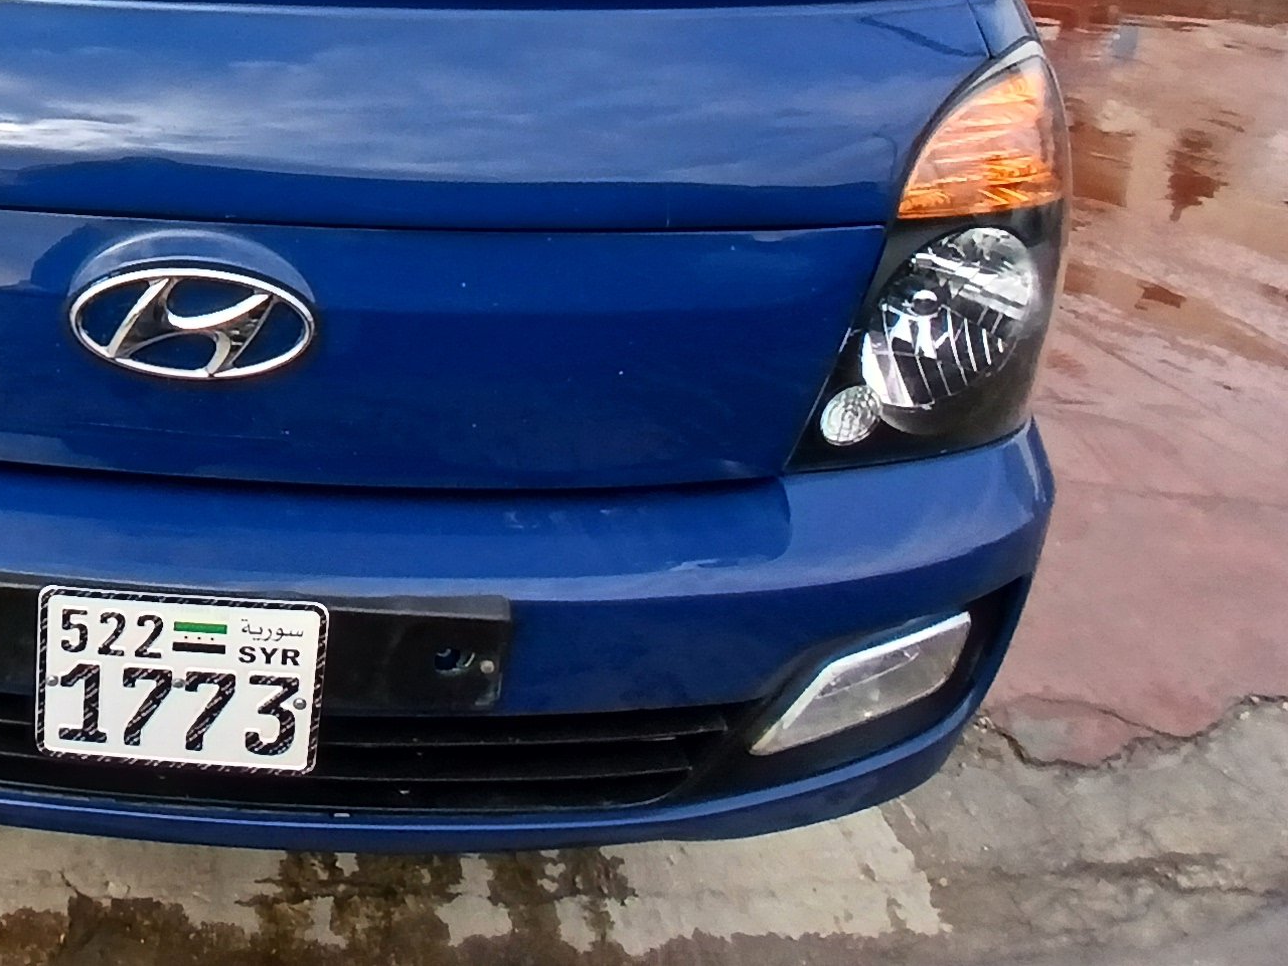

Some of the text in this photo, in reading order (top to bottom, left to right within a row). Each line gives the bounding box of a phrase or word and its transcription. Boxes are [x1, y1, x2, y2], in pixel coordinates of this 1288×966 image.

[60, 608, 164, 659] 522
[240, 618, 305, 642] سورية
[238, 645, 301, 666] SYR
[59, 663, 300, 756] 1773
